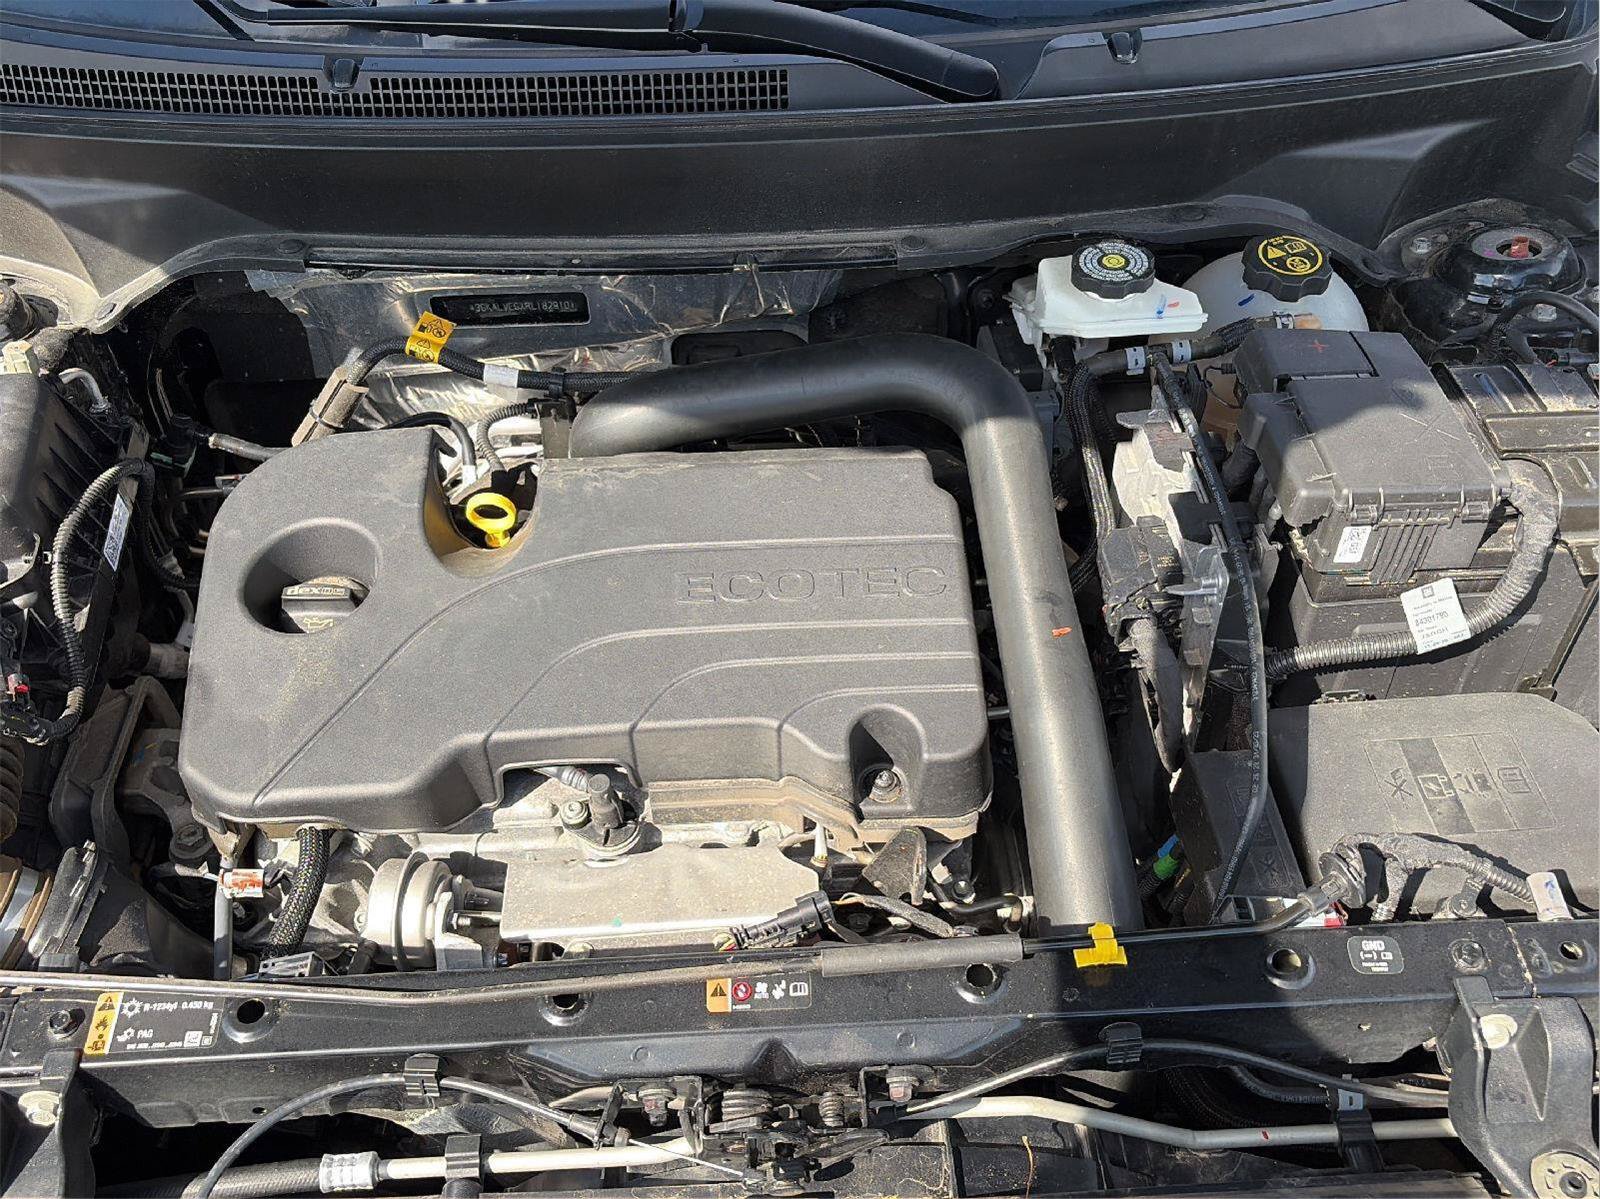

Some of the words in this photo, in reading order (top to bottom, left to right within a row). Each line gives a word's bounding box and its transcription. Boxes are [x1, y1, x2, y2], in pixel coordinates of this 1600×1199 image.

[678, 566, 947, 604] ECOTEC
[286, 586, 346, 596] dexos
[1361, 940, 1385, 951] GND
[143, 1001, 178, 1012] R-1234yf
[203, 1001, 214, 1010] kg
[136, 1029, 153, 1039] PAG
